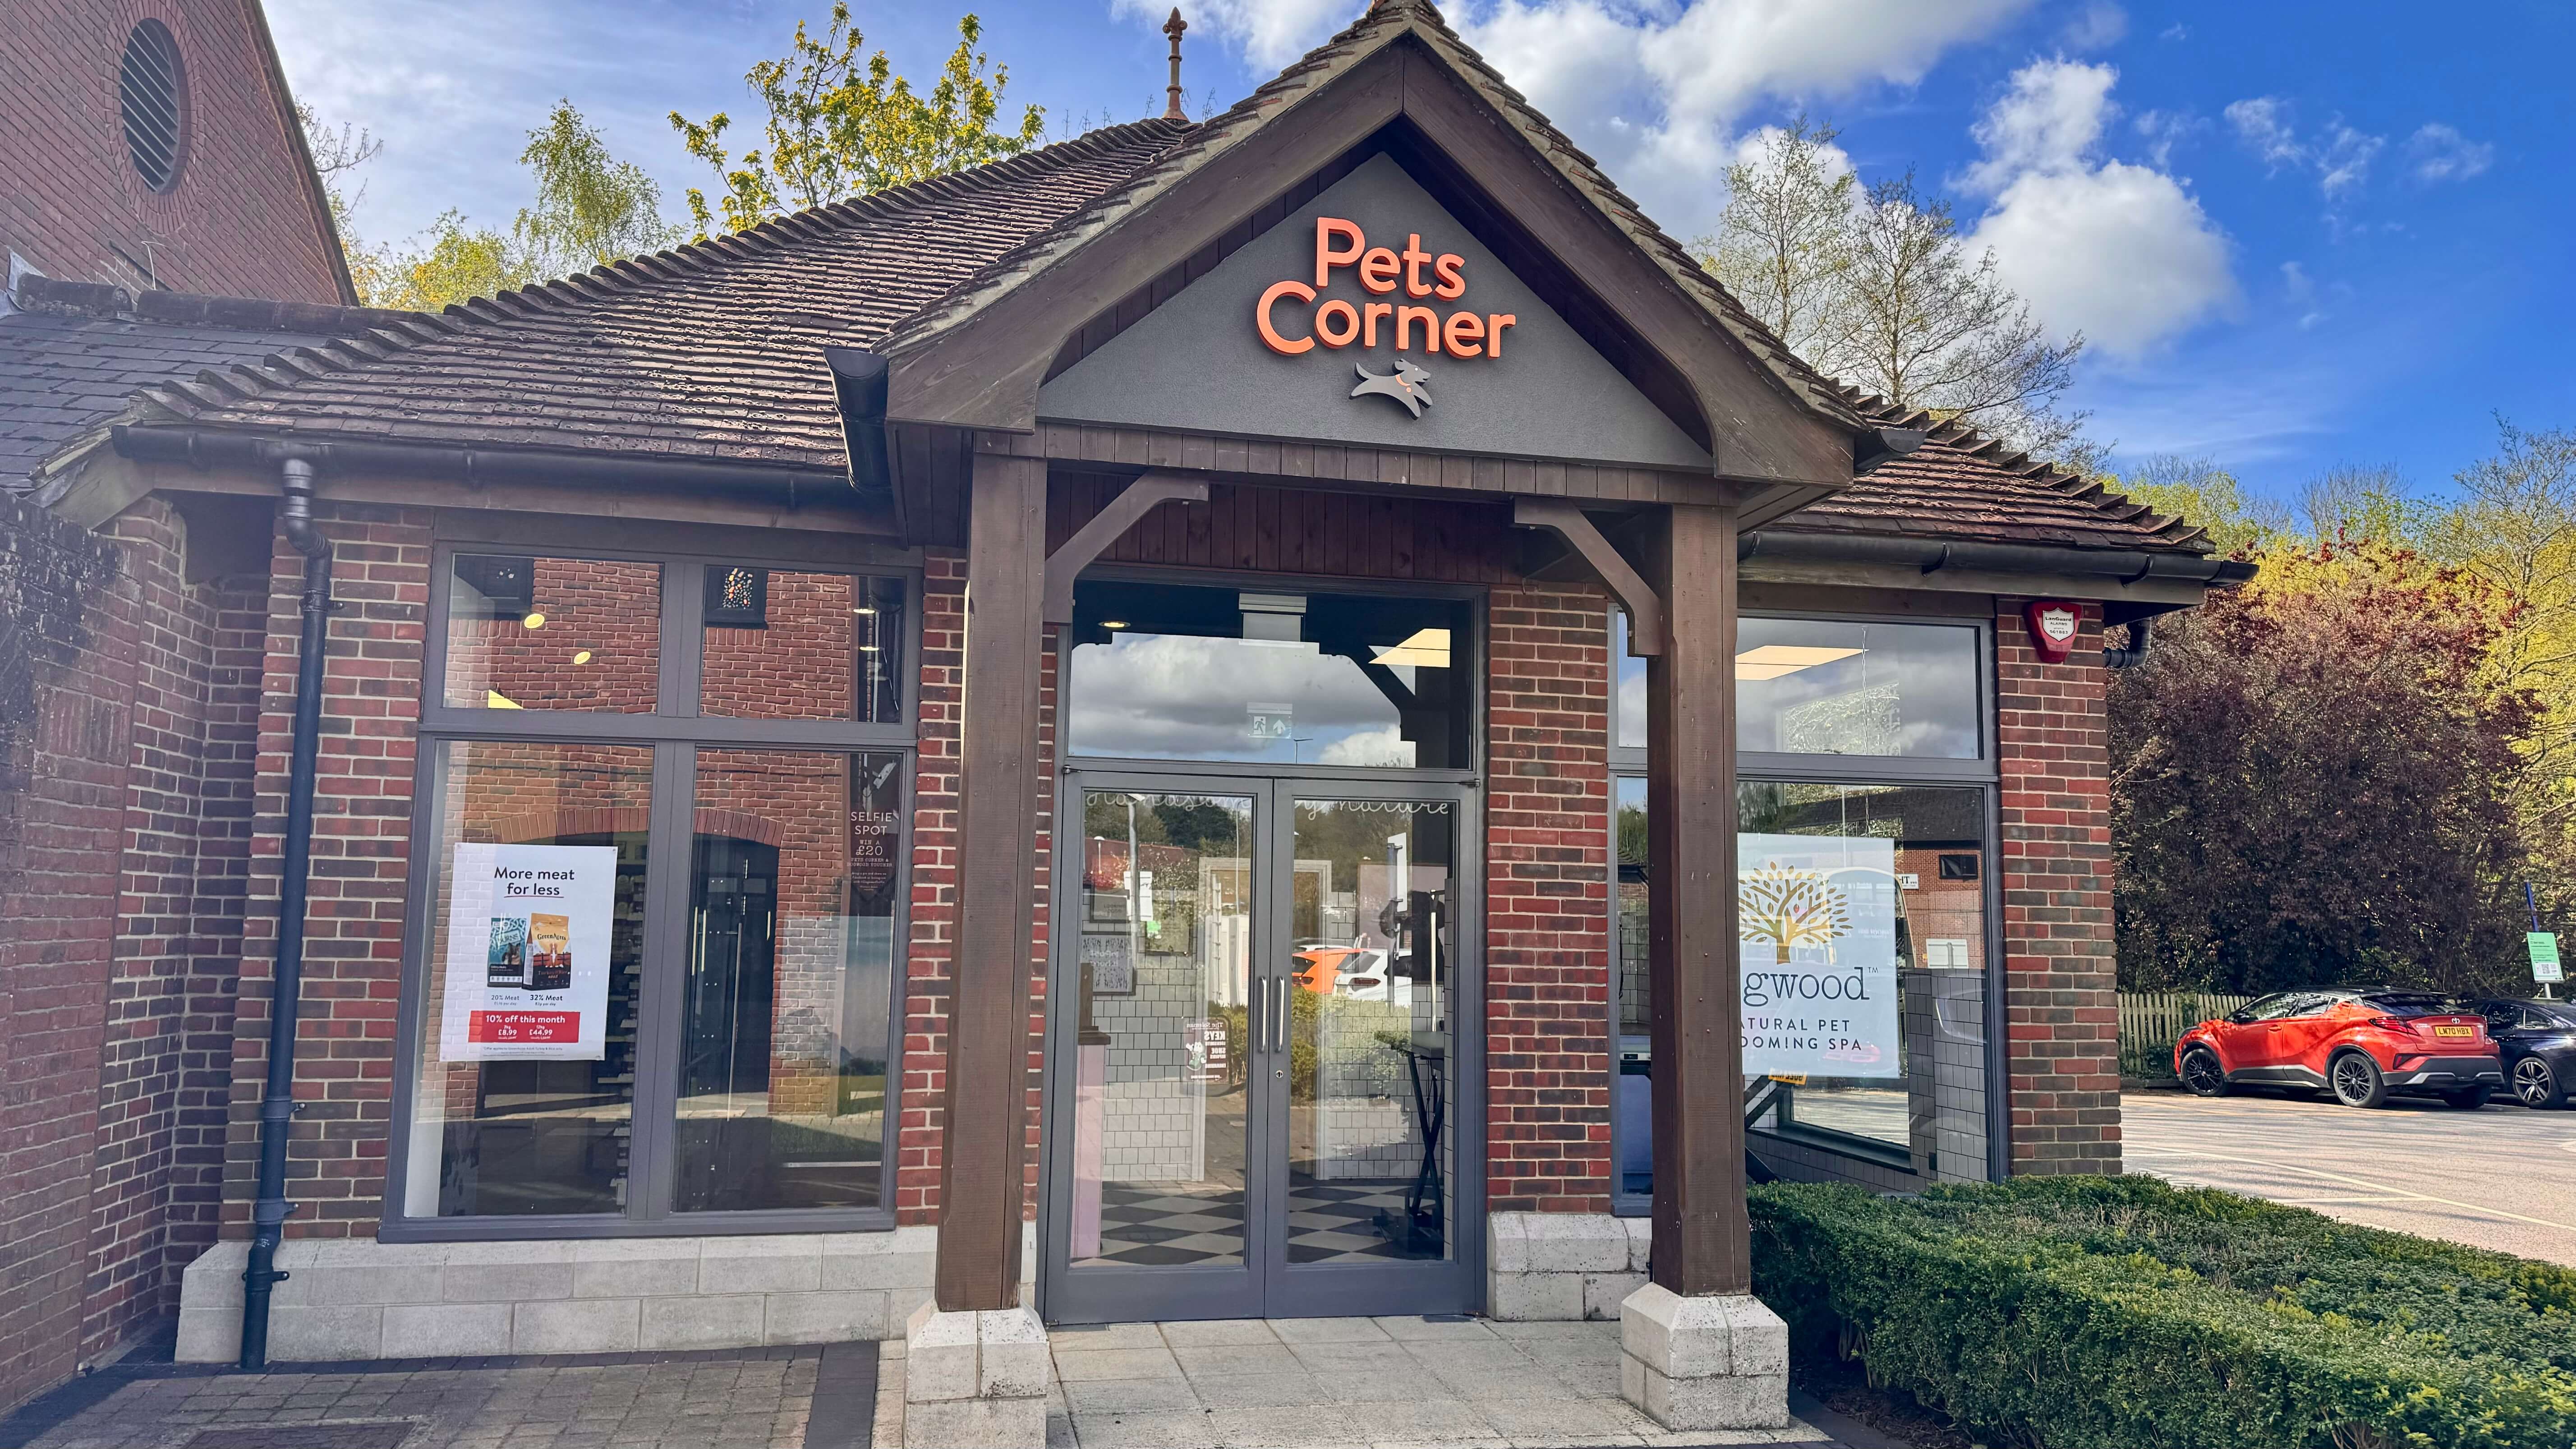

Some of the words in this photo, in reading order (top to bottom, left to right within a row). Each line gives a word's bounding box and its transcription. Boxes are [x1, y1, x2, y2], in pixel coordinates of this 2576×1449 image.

[1316, 216, 1466, 301] Pets
[1256, 280, 1516, 359] Corner
[851, 812, 892, 822] SELFIE
[855, 826, 887, 836] SPOT
[856, 845, 883, 856] £20
[494, 866, 533, 879] More
[538, 869, 575, 880] meat
[507, 883, 529, 894] for
[534, 883, 559, 895] less
[1743, 966, 1870, 1007] gwood
[486, 1015, 502, 1023] 10%
[505, 1015, 518, 1023] off
[1818, 1019, 1849, 1032] PET
[1829, 1038, 1861, 1051] SPA
